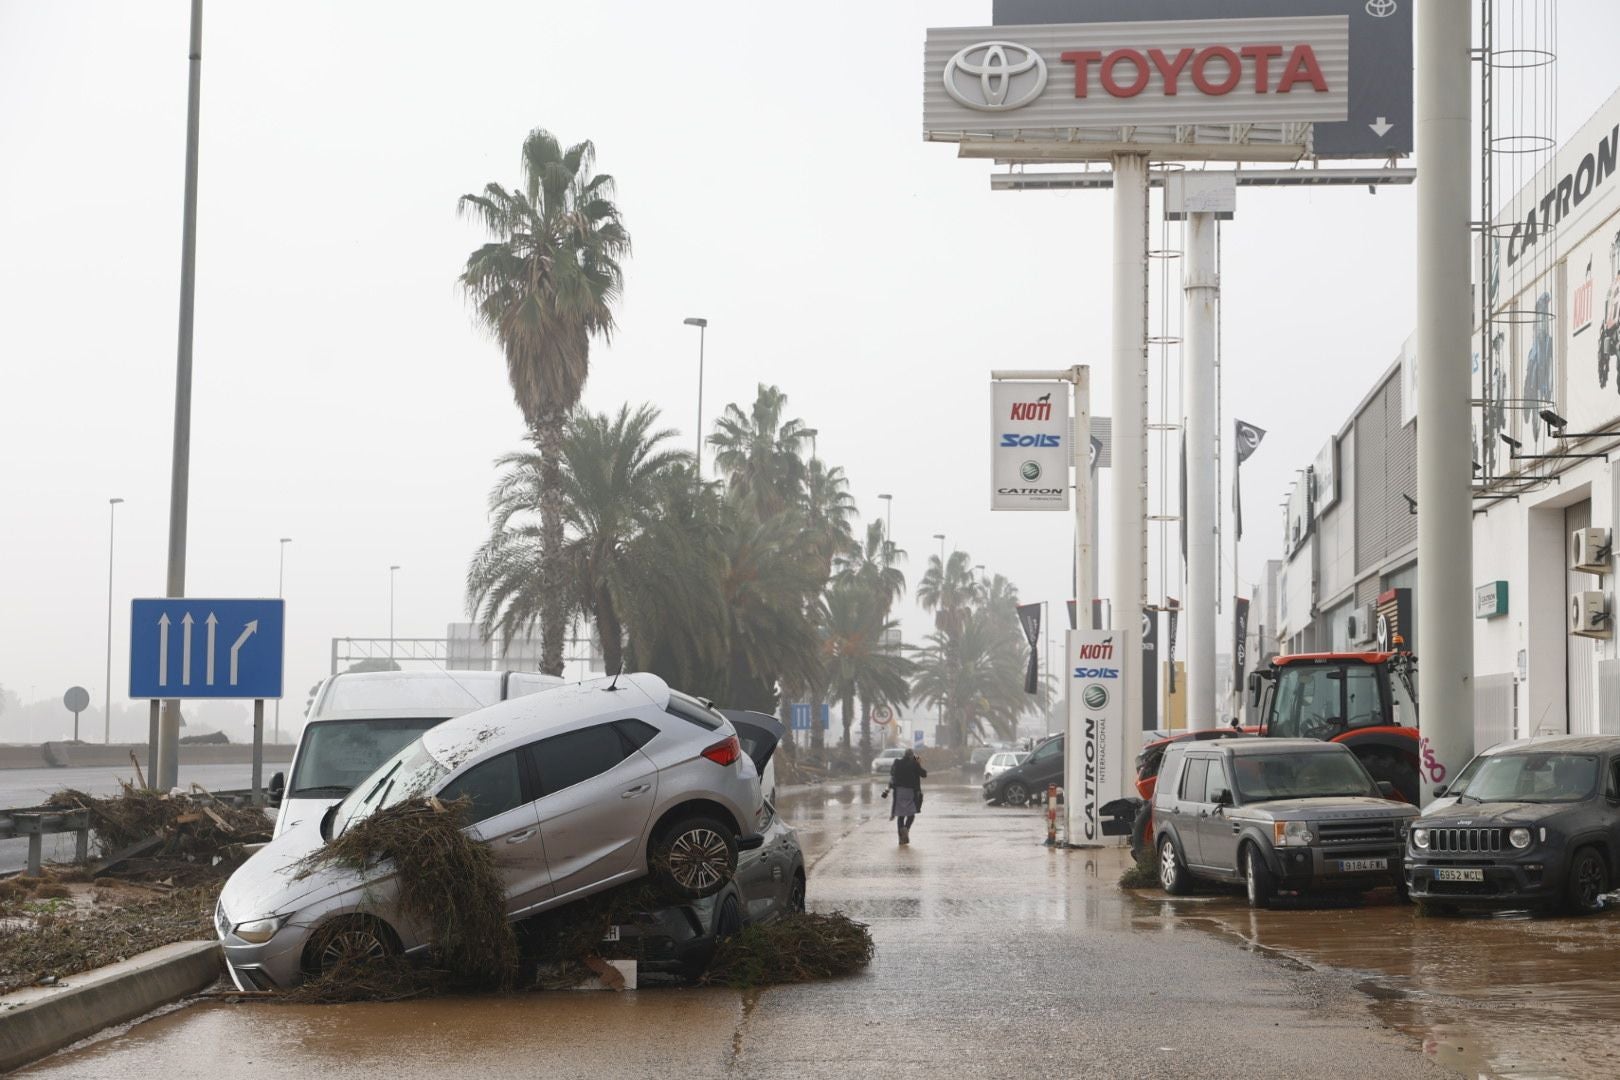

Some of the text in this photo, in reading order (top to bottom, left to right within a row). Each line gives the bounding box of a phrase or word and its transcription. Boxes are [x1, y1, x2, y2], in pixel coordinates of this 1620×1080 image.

[1061, 43, 1329, 98] TOYOTA
[1507, 123, 1620, 268] CATRON
[1010, 402, 1052, 421] KIOTI
[1080, 644, 1113, 660] KIOTI
[1085, 718, 1095, 841] CATRON
[1345, 860, 1367, 871] 9184
[1440, 869, 1481, 880] 6952 MCL
